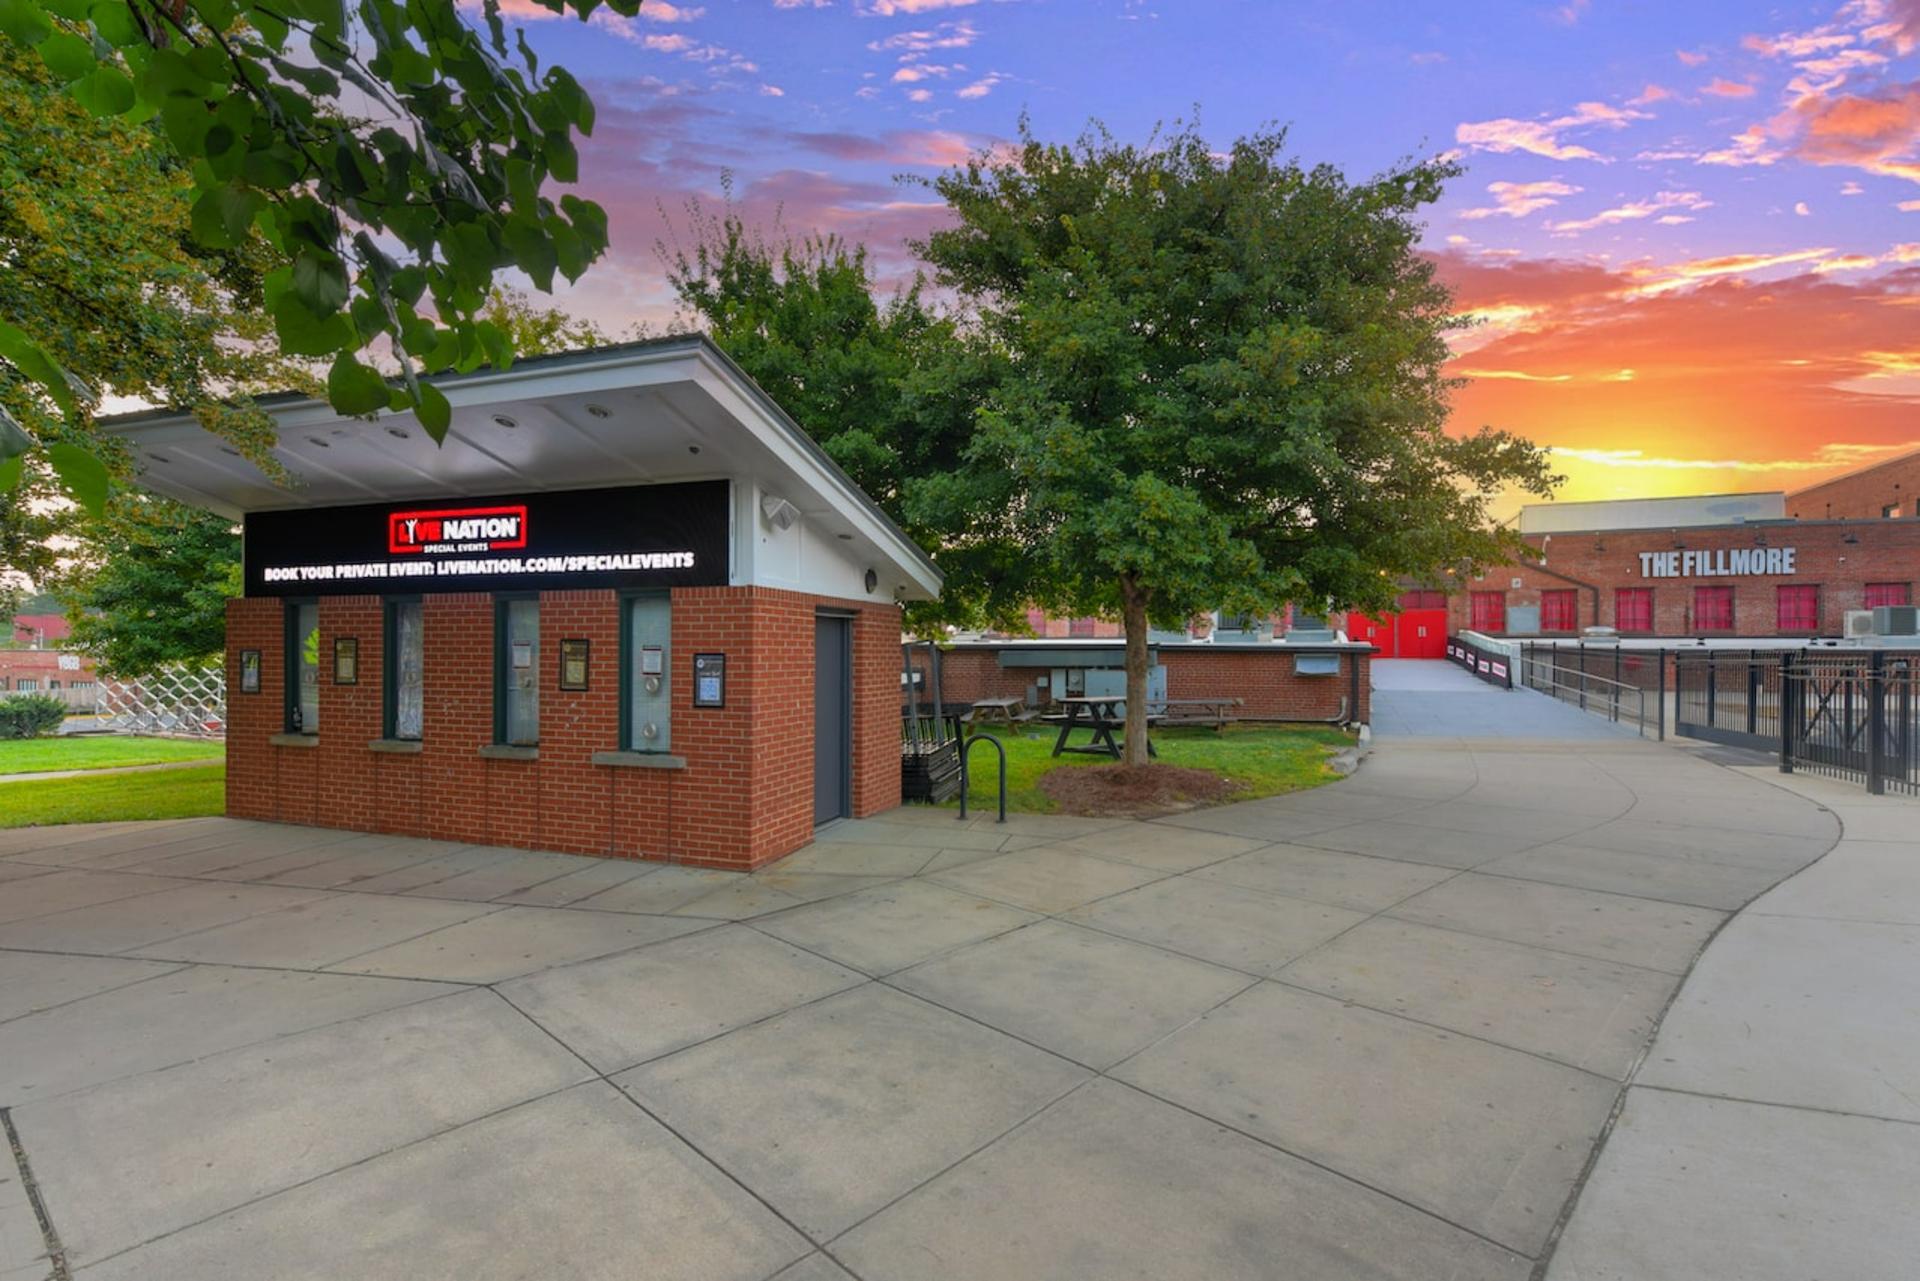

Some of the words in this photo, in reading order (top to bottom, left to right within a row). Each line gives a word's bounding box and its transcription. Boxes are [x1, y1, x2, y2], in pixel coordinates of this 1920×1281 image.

[399, 518, 441, 544] LIVE
[443, 517, 518, 540] NATION
[424, 543, 456, 554] SPECIAL
[458, 542, 489, 553] EVENTS
[264, 567, 299, 581] BOOK
[299, 565, 334, 580] YOUR
[335, 562, 388, 579] PRIVATE
[389, 561, 435, 578] EVENT:
[436, 552, 695, 576] LIVENATION.COM/SPECIALEVENTS
[1638, 551, 1680, 578] THE
[1682, 547, 1796, 577] FILLMORE
